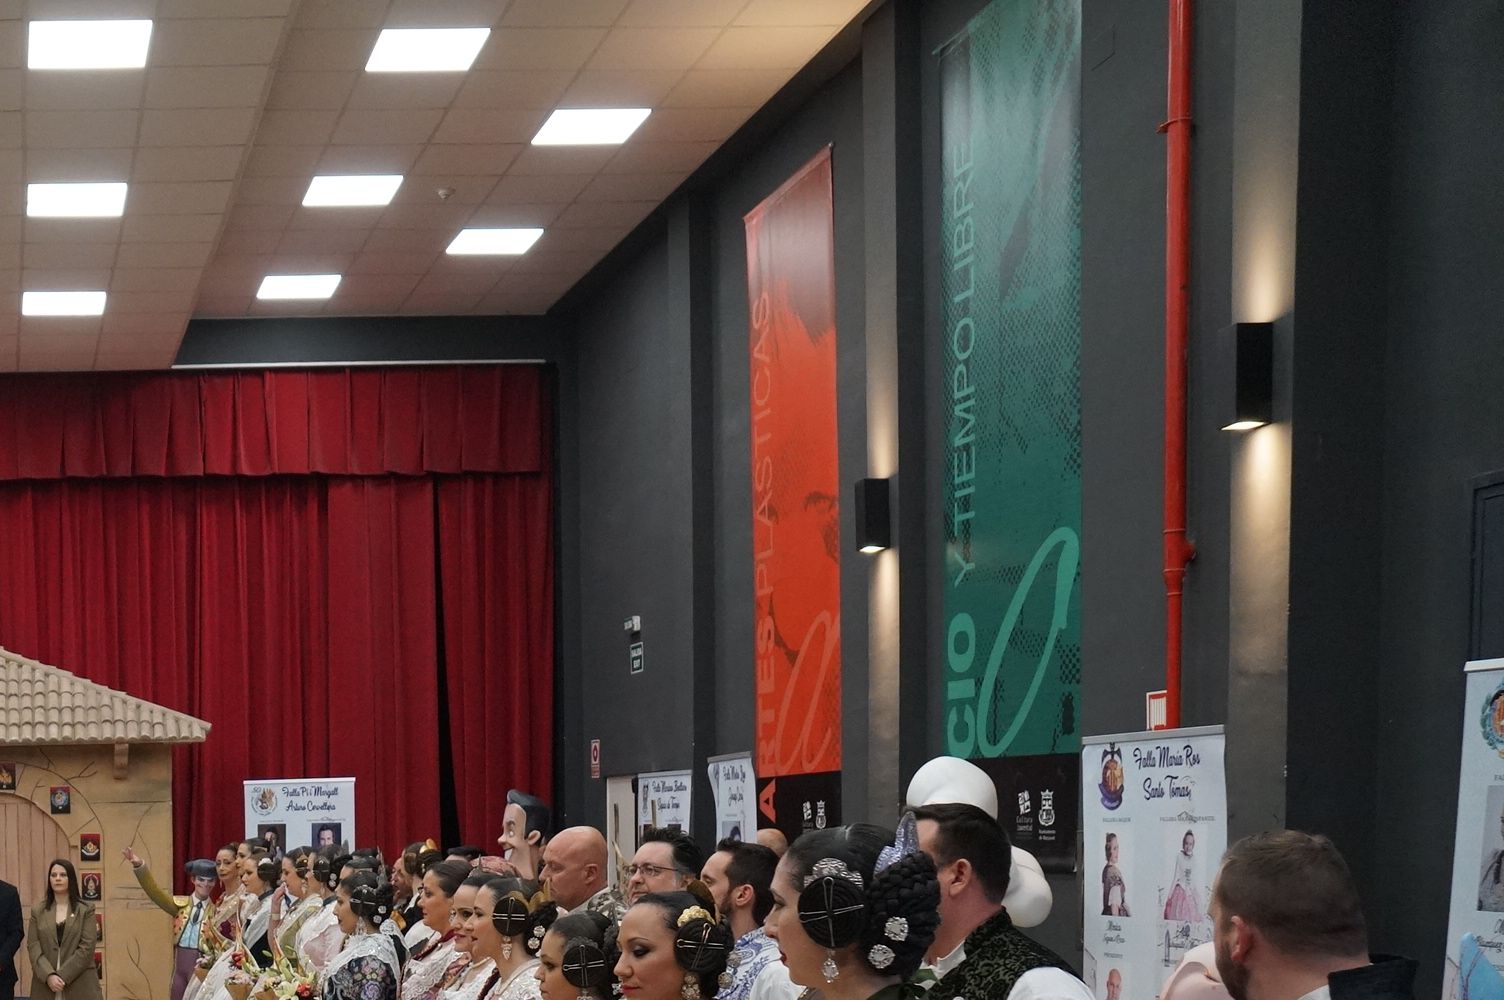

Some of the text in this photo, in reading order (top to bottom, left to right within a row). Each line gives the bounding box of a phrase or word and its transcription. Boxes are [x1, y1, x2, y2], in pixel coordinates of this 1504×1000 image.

[951, 148, 977, 588] Y TIEMPO LIBRE
[756, 618, 779, 826] ARTES
[946, 608, 978, 758] CIO
[282, 786, 300, 798] Falla
[311, 785, 339, 799] Margall
[1133, 744, 1201, 770] Falla María Ros
[1142, 777, 1165, 801] Santo
